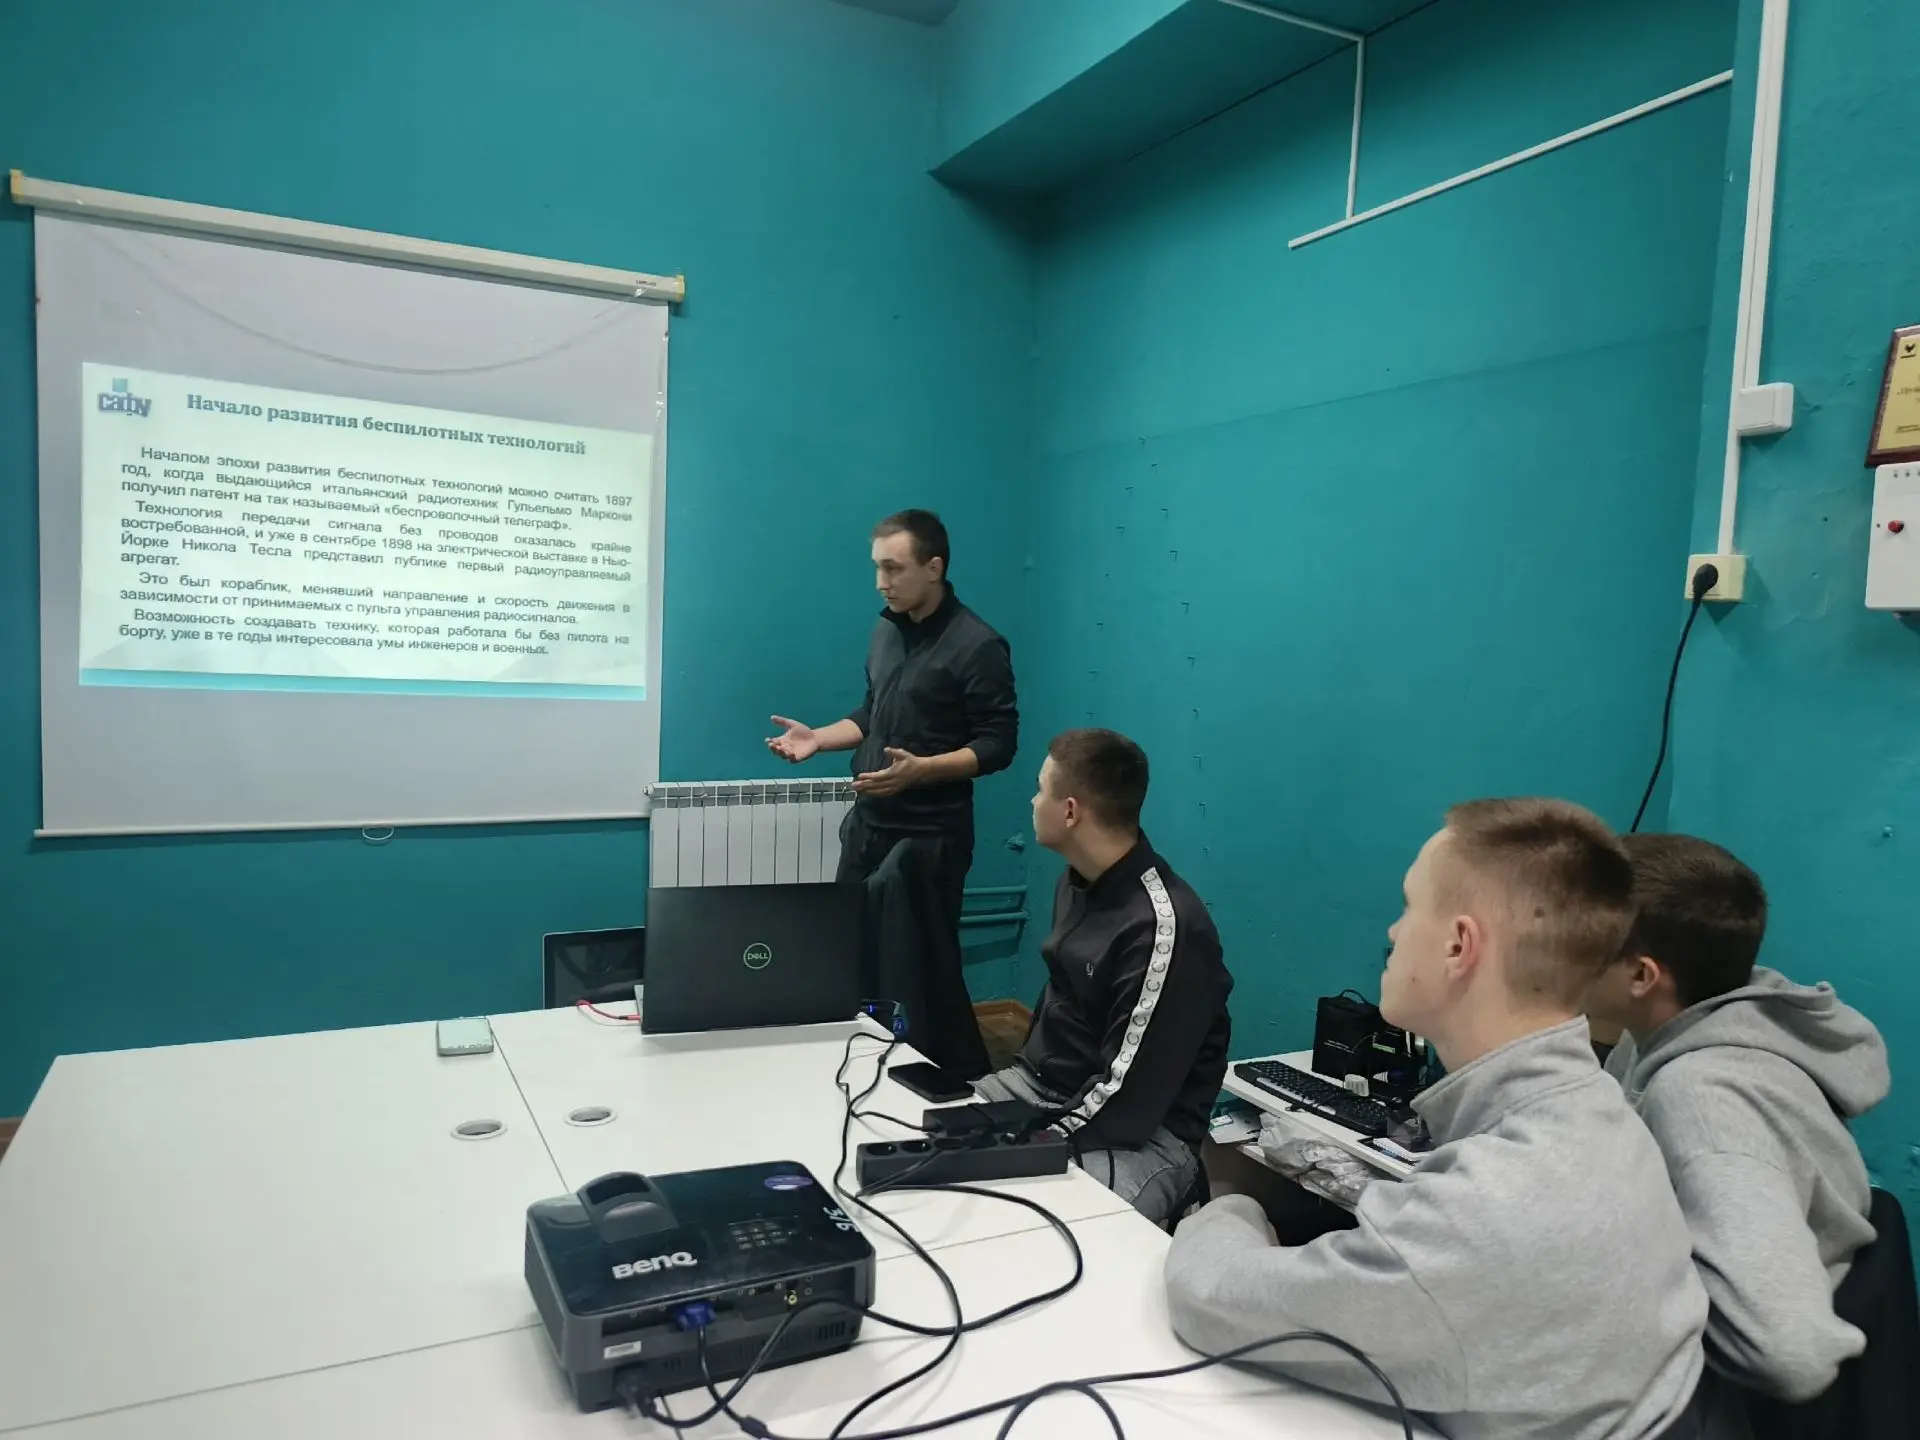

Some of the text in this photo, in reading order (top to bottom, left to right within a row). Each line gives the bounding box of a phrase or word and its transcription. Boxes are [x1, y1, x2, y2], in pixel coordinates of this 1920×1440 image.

[187, 393, 586, 455] Начало развития беспилотных технологий
[141, 446, 633, 507] Началом эпохи развития беспилотных технологий можно считать 1897
[163, 468, 205, 483] когда
[216, 473, 312, 491] выдающийся
[322, 484, 408, 501] итальянский
[417, 493, 498, 509] радиотехник
[507, 499, 573, 516] Гульельмо
[580, 506, 633, 522] Маркони
[121, 481, 186, 497] получил
[190, 487, 240, 501] патент
[243, 493, 262, 504] на
[266, 494, 289, 506] так
[292, 497, 380, 514] называемый
[384, 504, 500, 525] «беспроволочный
[120, 518, 631, 568] востребованной, и уже в сентябре 1898 на электрической выставке в Нью-
[135, 499, 632, 554] Технология передачи сигнала без проводов оказалась крайне
[120, 552, 180, 566] агрегат.
[121, 530, 631, 582] Йорке Никола Тесла представил публике первый радиоуправляемый
[120, 589, 219, 605] зависимости
[222, 596, 239, 606] от
[242, 596, 342, 611] принимаемых
[345, 603, 353, 612] с
[356, 603, 402, 616] пульта
[404, 607, 481, 619] управления
[138, 571, 631, 614] Это был кораблик, менявший направление и скорость движения в
[134, 607, 236, 626] Возможность
[243, 616, 317, 630] создавать
[388, 624, 440, 636] которая
[447, 625, 507, 639] работала
[514, 627, 532, 640] бы
[539, 629, 560, 641] без
[567, 632, 609, 644] пилота
[614, 635, 630, 645] на
[170, 629, 201, 642] уже
[204, 630, 214, 641] в
[217, 631, 234, 641] те
[237, 631, 273, 644] годы
[275, 634, 373, 648] интересовала
[377, 639, 404, 650] умы
[408, 640, 479, 653] инженеров
[481, 643, 490, 652] и
[612, 1251, 698, 1279] BenQ
